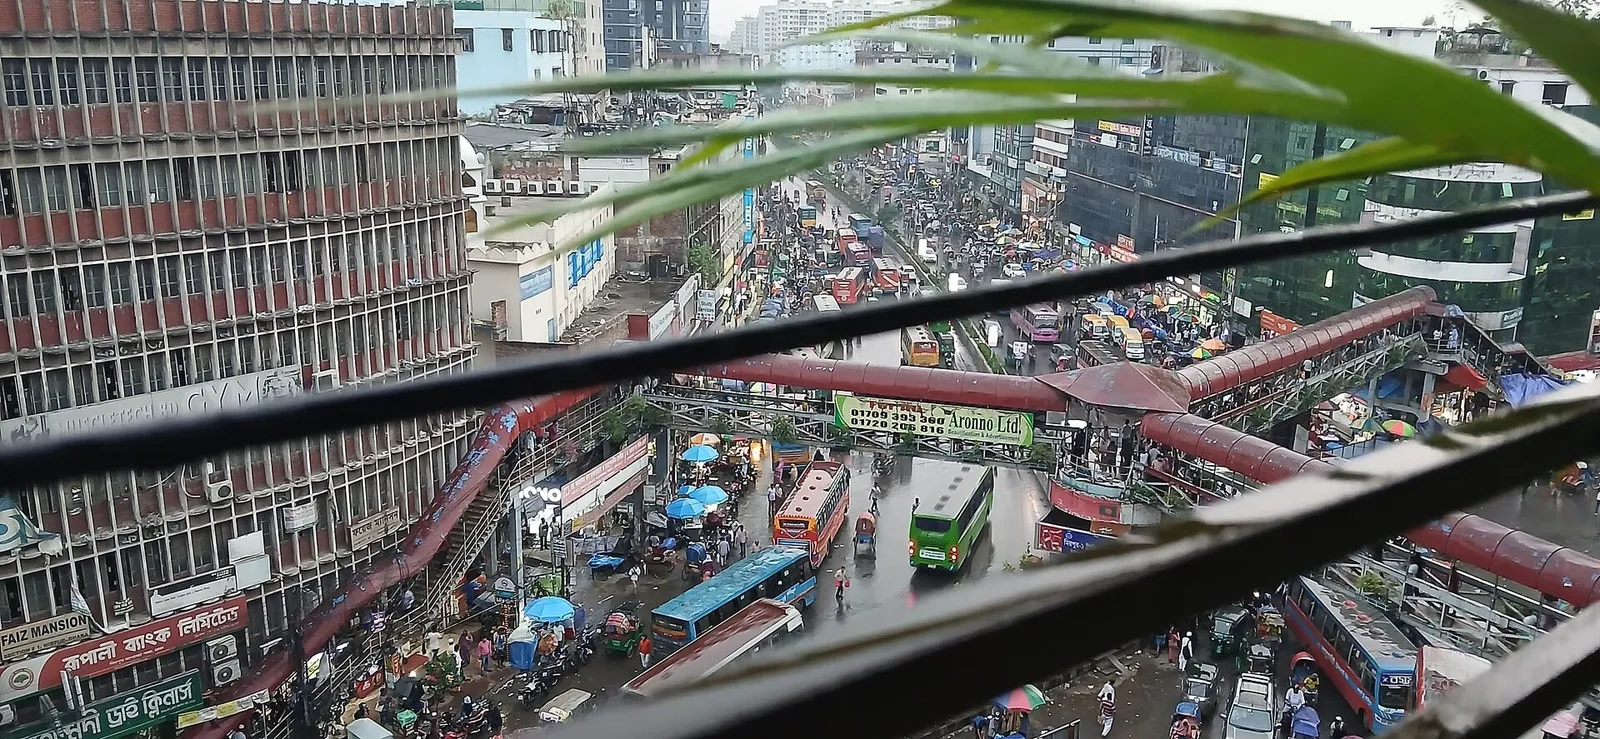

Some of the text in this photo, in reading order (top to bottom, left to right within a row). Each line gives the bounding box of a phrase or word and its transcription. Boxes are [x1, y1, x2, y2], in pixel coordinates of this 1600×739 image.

[187, 376, 260, 413] GYM
[851, 409, 888, 419] 01709
[892, 412, 916, 422] 393
[851, 418, 888, 428] 01720
[920, 425, 944, 434] 816
[949, 411, 993, 431] Aronno
[1, 615, 87, 646] FAIZ MANSION
[123, 627, 171, 651] ব্যাংক
[177, 605, 239, 638] লিমিটেড
[105, 697, 139, 727] ড্রাই
[141, 678, 192, 718] ক্লিনার্স
